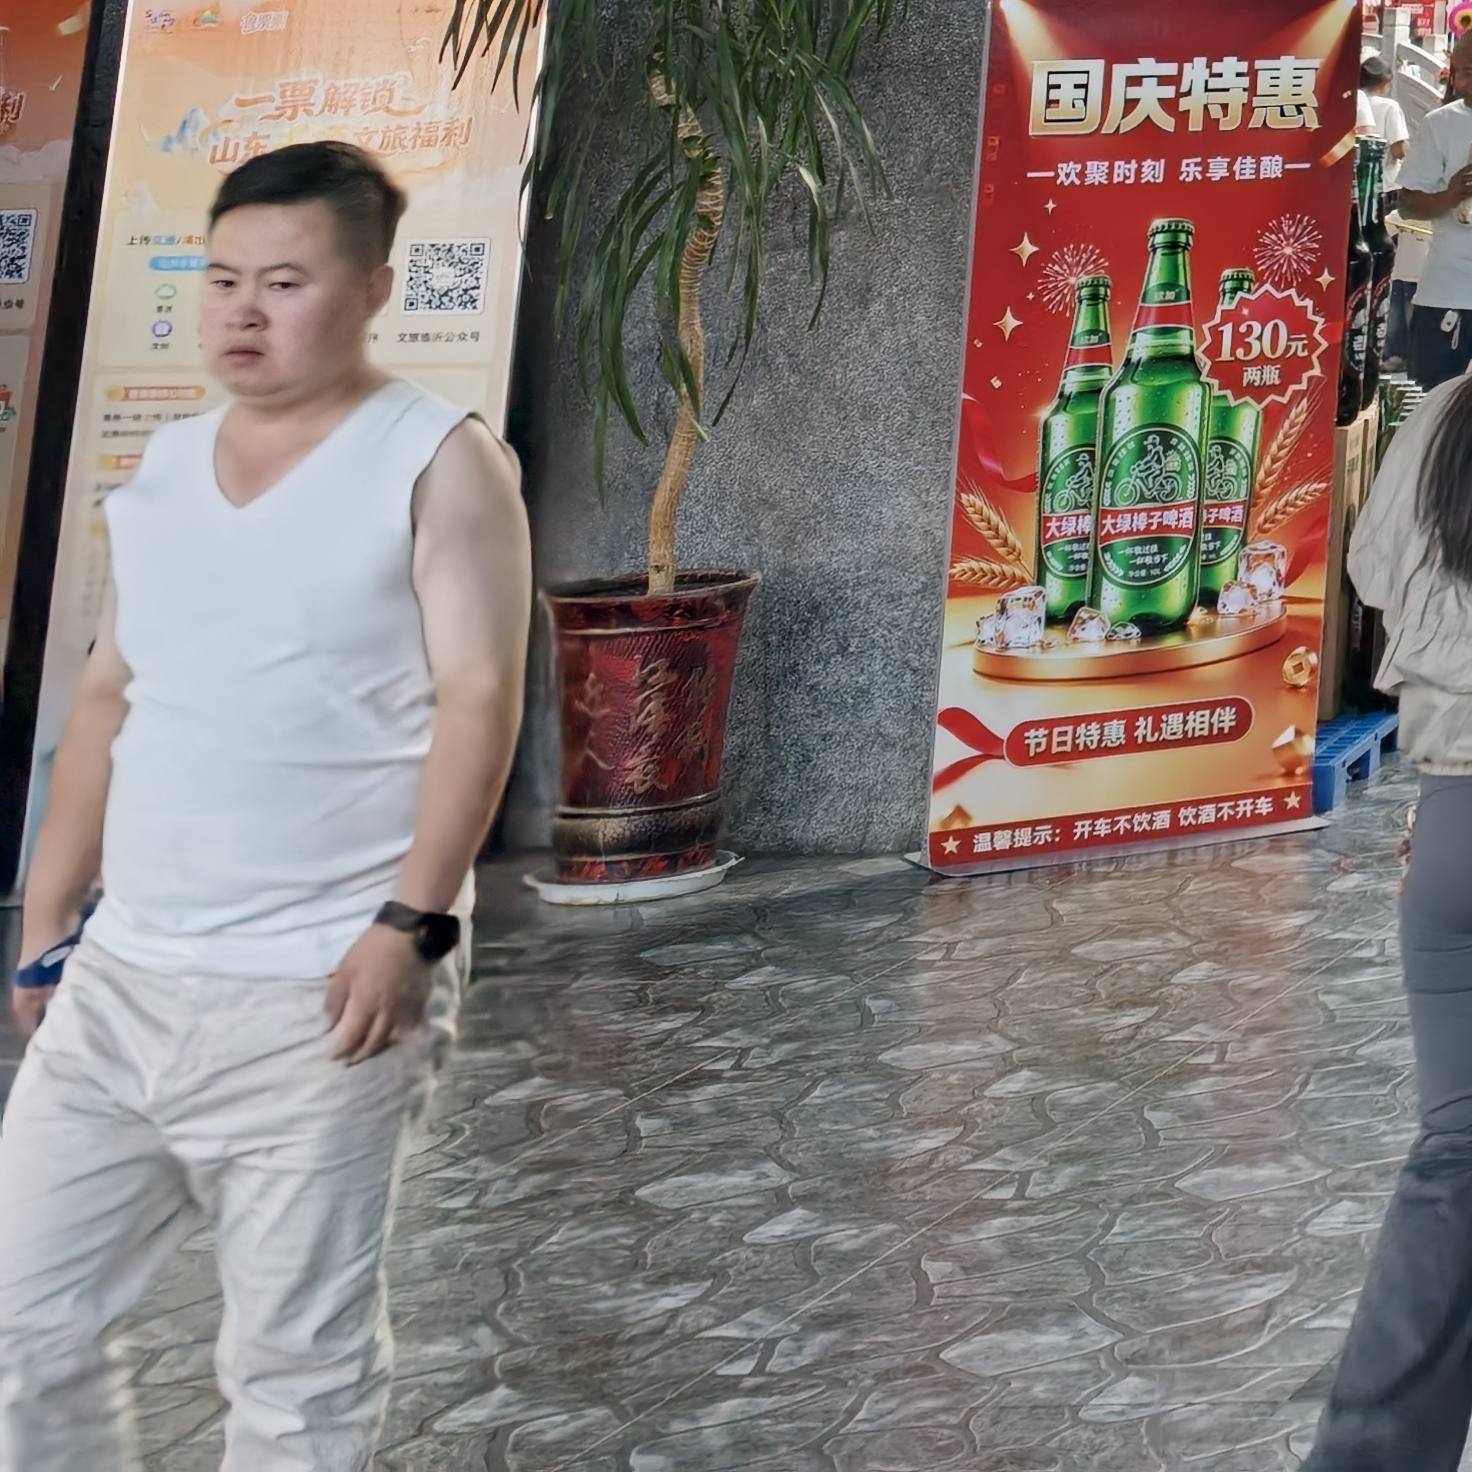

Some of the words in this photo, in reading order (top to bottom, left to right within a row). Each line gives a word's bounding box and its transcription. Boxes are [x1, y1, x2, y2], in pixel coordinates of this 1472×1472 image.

[234, 78, 420, 122] 一票解锁
[1029, 57, 1321, 136] 国庆特惠
[1056, 157, 1165, 186] 欢聚时刻
[1179, 155, 1283, 182] 乐享佳酿
[1215, 318, 1309, 363] 130元
[1243, 365, 1281, 387] 两瓶
[1101, 506, 1195, 536] 大绿棒子啤酒
[1202, 506, 1244, 525] 子啤酒
[1023, 716, 1127, 758] 节日特惠
[1134, 706, 1237, 746] 礼遇相伴
[1178, 798, 1273, 828] 饮酒不开车
